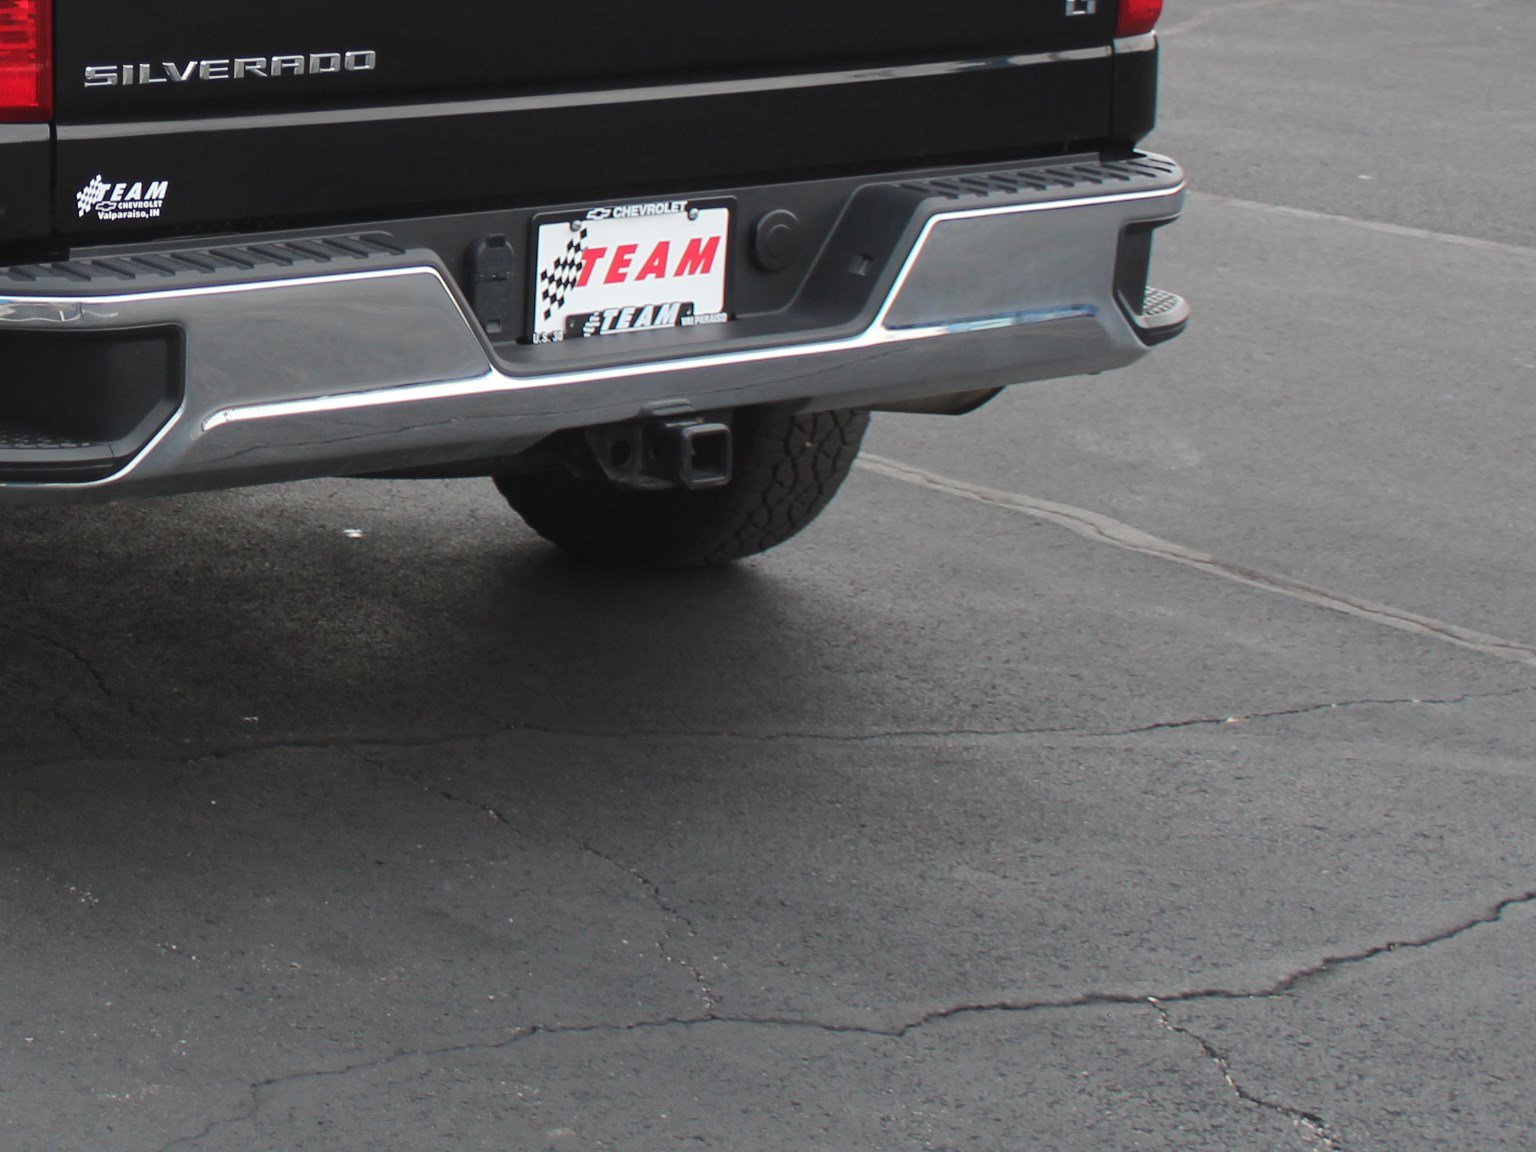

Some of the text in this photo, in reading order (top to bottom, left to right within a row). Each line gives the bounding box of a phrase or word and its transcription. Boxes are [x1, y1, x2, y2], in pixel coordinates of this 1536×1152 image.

[83, 50, 376, 88] SILVERADO
[95, 181, 168, 201] TEAM
[97, 208, 160, 220] Valparaiso, IN
[117, 200, 163, 209] CHEVROLET
[611, 200, 688, 219] CHEVROLET
[576, 236, 721, 288] TEAM
[600, 302, 681, 331] TEAM
